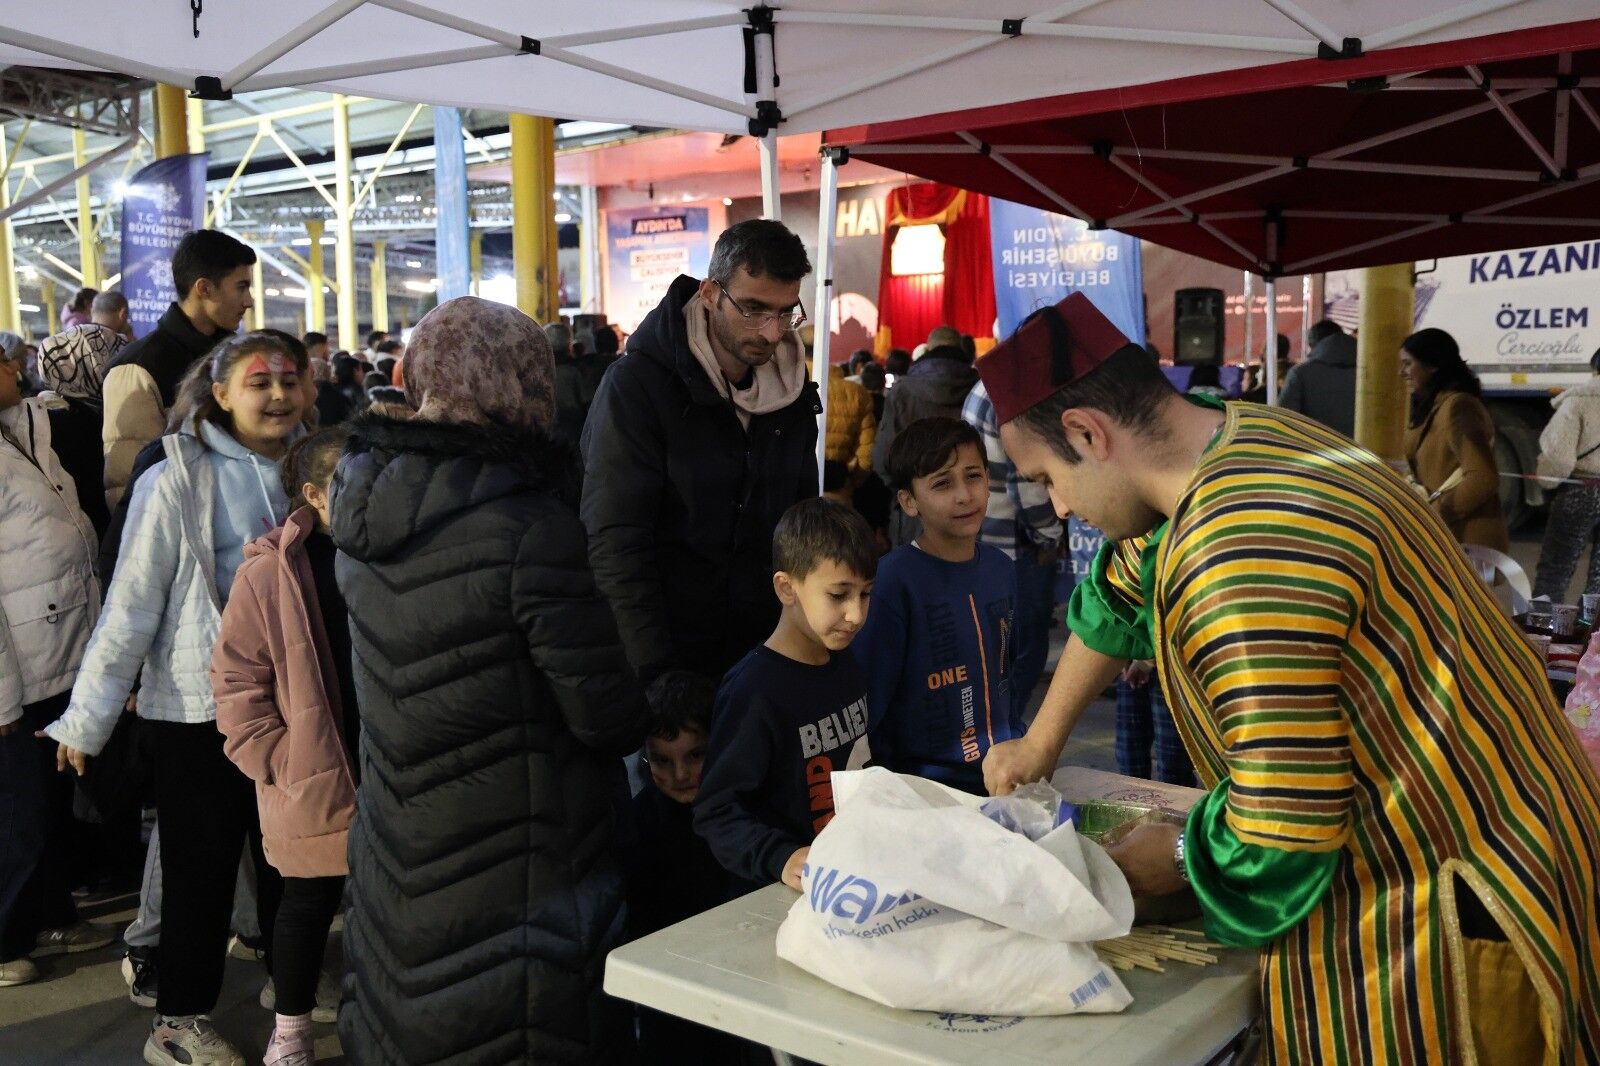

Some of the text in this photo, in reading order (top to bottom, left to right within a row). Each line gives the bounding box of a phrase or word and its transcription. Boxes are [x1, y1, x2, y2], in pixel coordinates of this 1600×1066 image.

[132, 235, 180, 248] BELEDİY
[1469, 242, 1600, 283] KAZANI
[1496, 303, 1588, 329] ÖZLEM
[927, 665, 967, 690] ONE
[798, 693, 869, 759] BELIEV
[961, 727, 981, 763] GUYS
